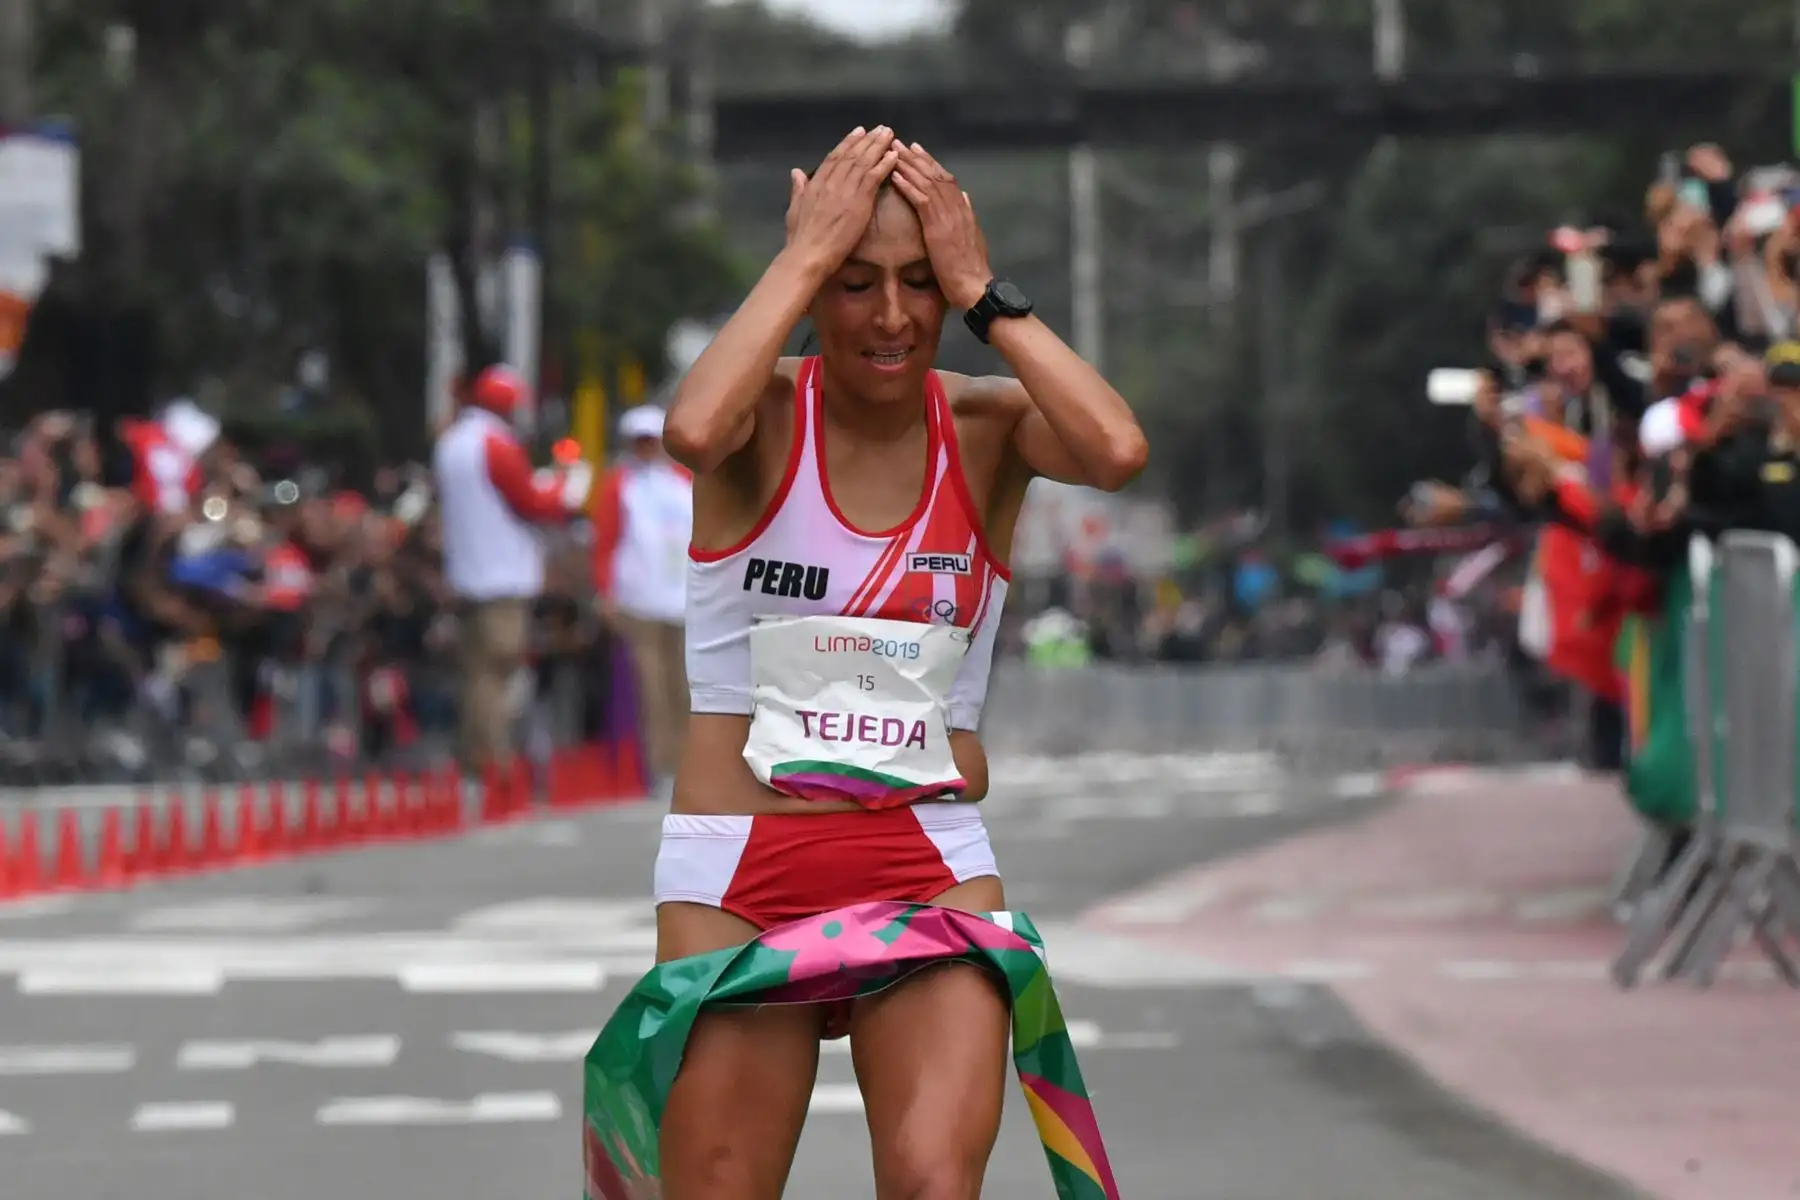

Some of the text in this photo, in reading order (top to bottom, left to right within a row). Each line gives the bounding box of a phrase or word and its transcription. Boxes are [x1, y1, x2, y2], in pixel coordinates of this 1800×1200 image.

[912, 556, 969, 572] PERU
[743, 558, 829, 600] PERU
[856, 674, 875, 691] 15
[795, 710, 926, 750] TEJEDA
